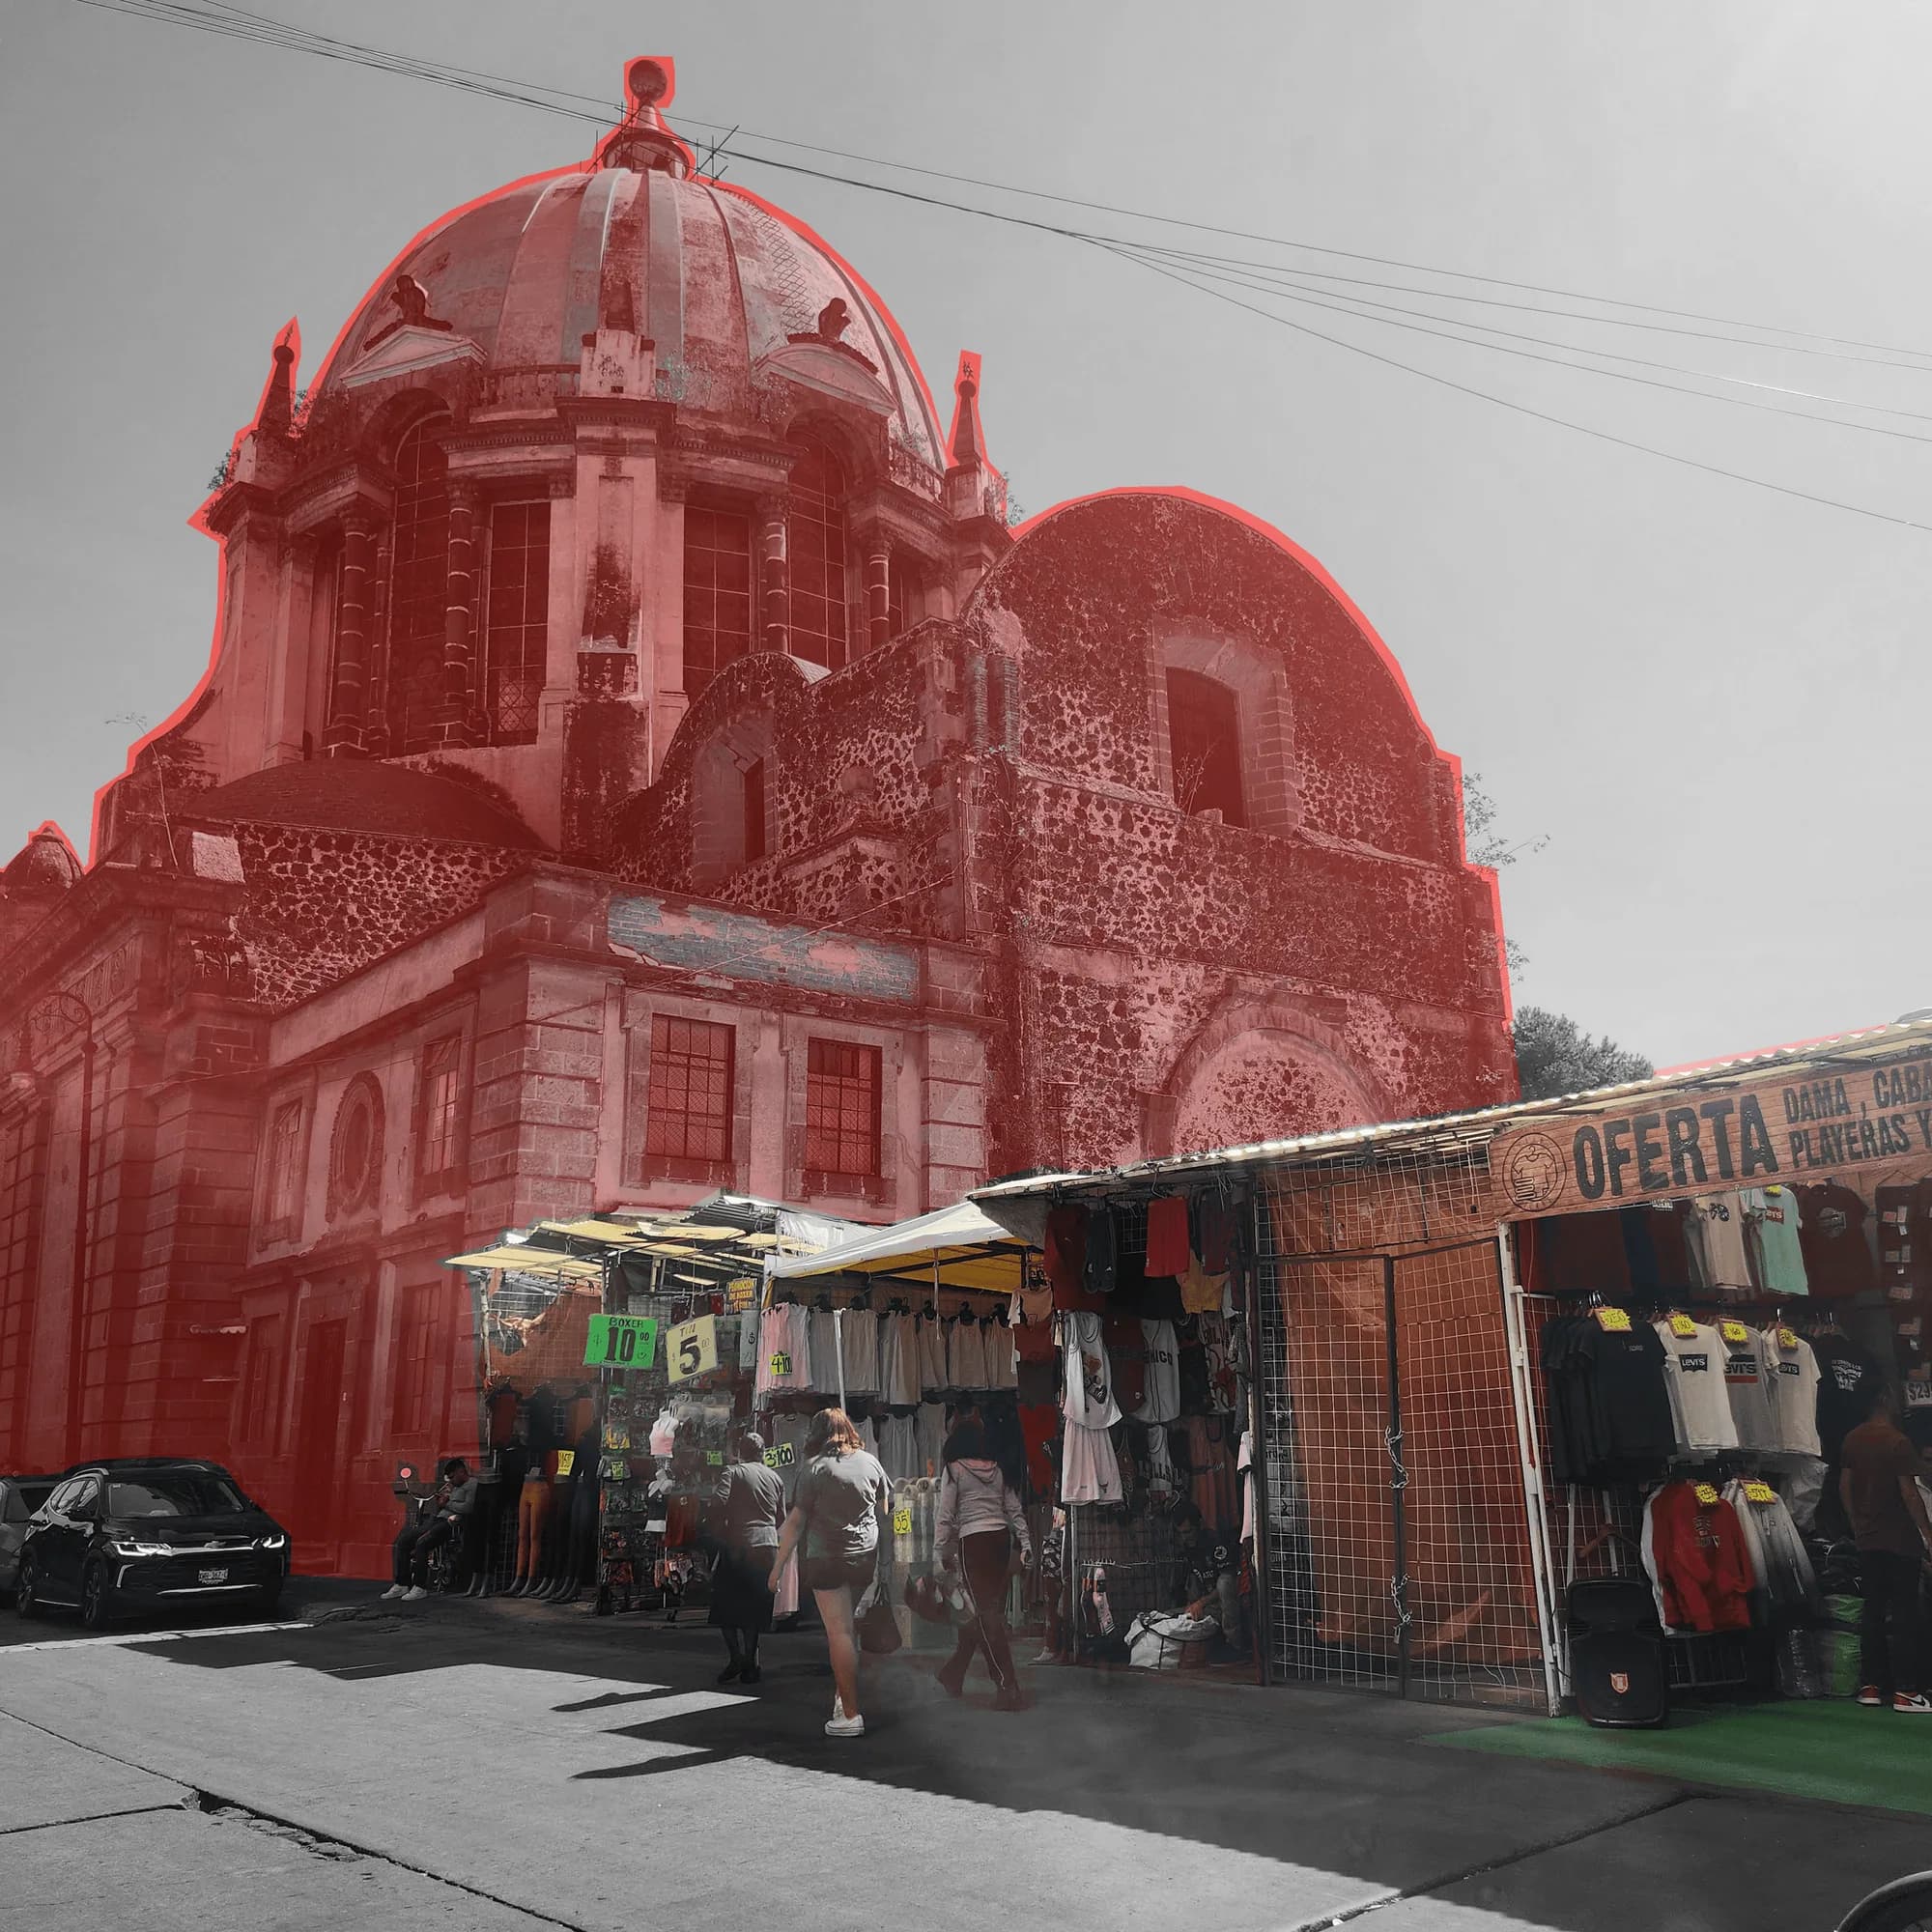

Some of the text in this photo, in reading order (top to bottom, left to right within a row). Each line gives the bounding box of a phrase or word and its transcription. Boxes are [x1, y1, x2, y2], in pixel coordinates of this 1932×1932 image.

[1573, 1094, 1778, 1200] OFERTA
[1789, 1114, 1910, 1169] PLAYERAS
[609, 1317, 643, 1328] BOXER
[604, 1326, 636, 1362] 10
[679, 1334, 701, 1376] 5
